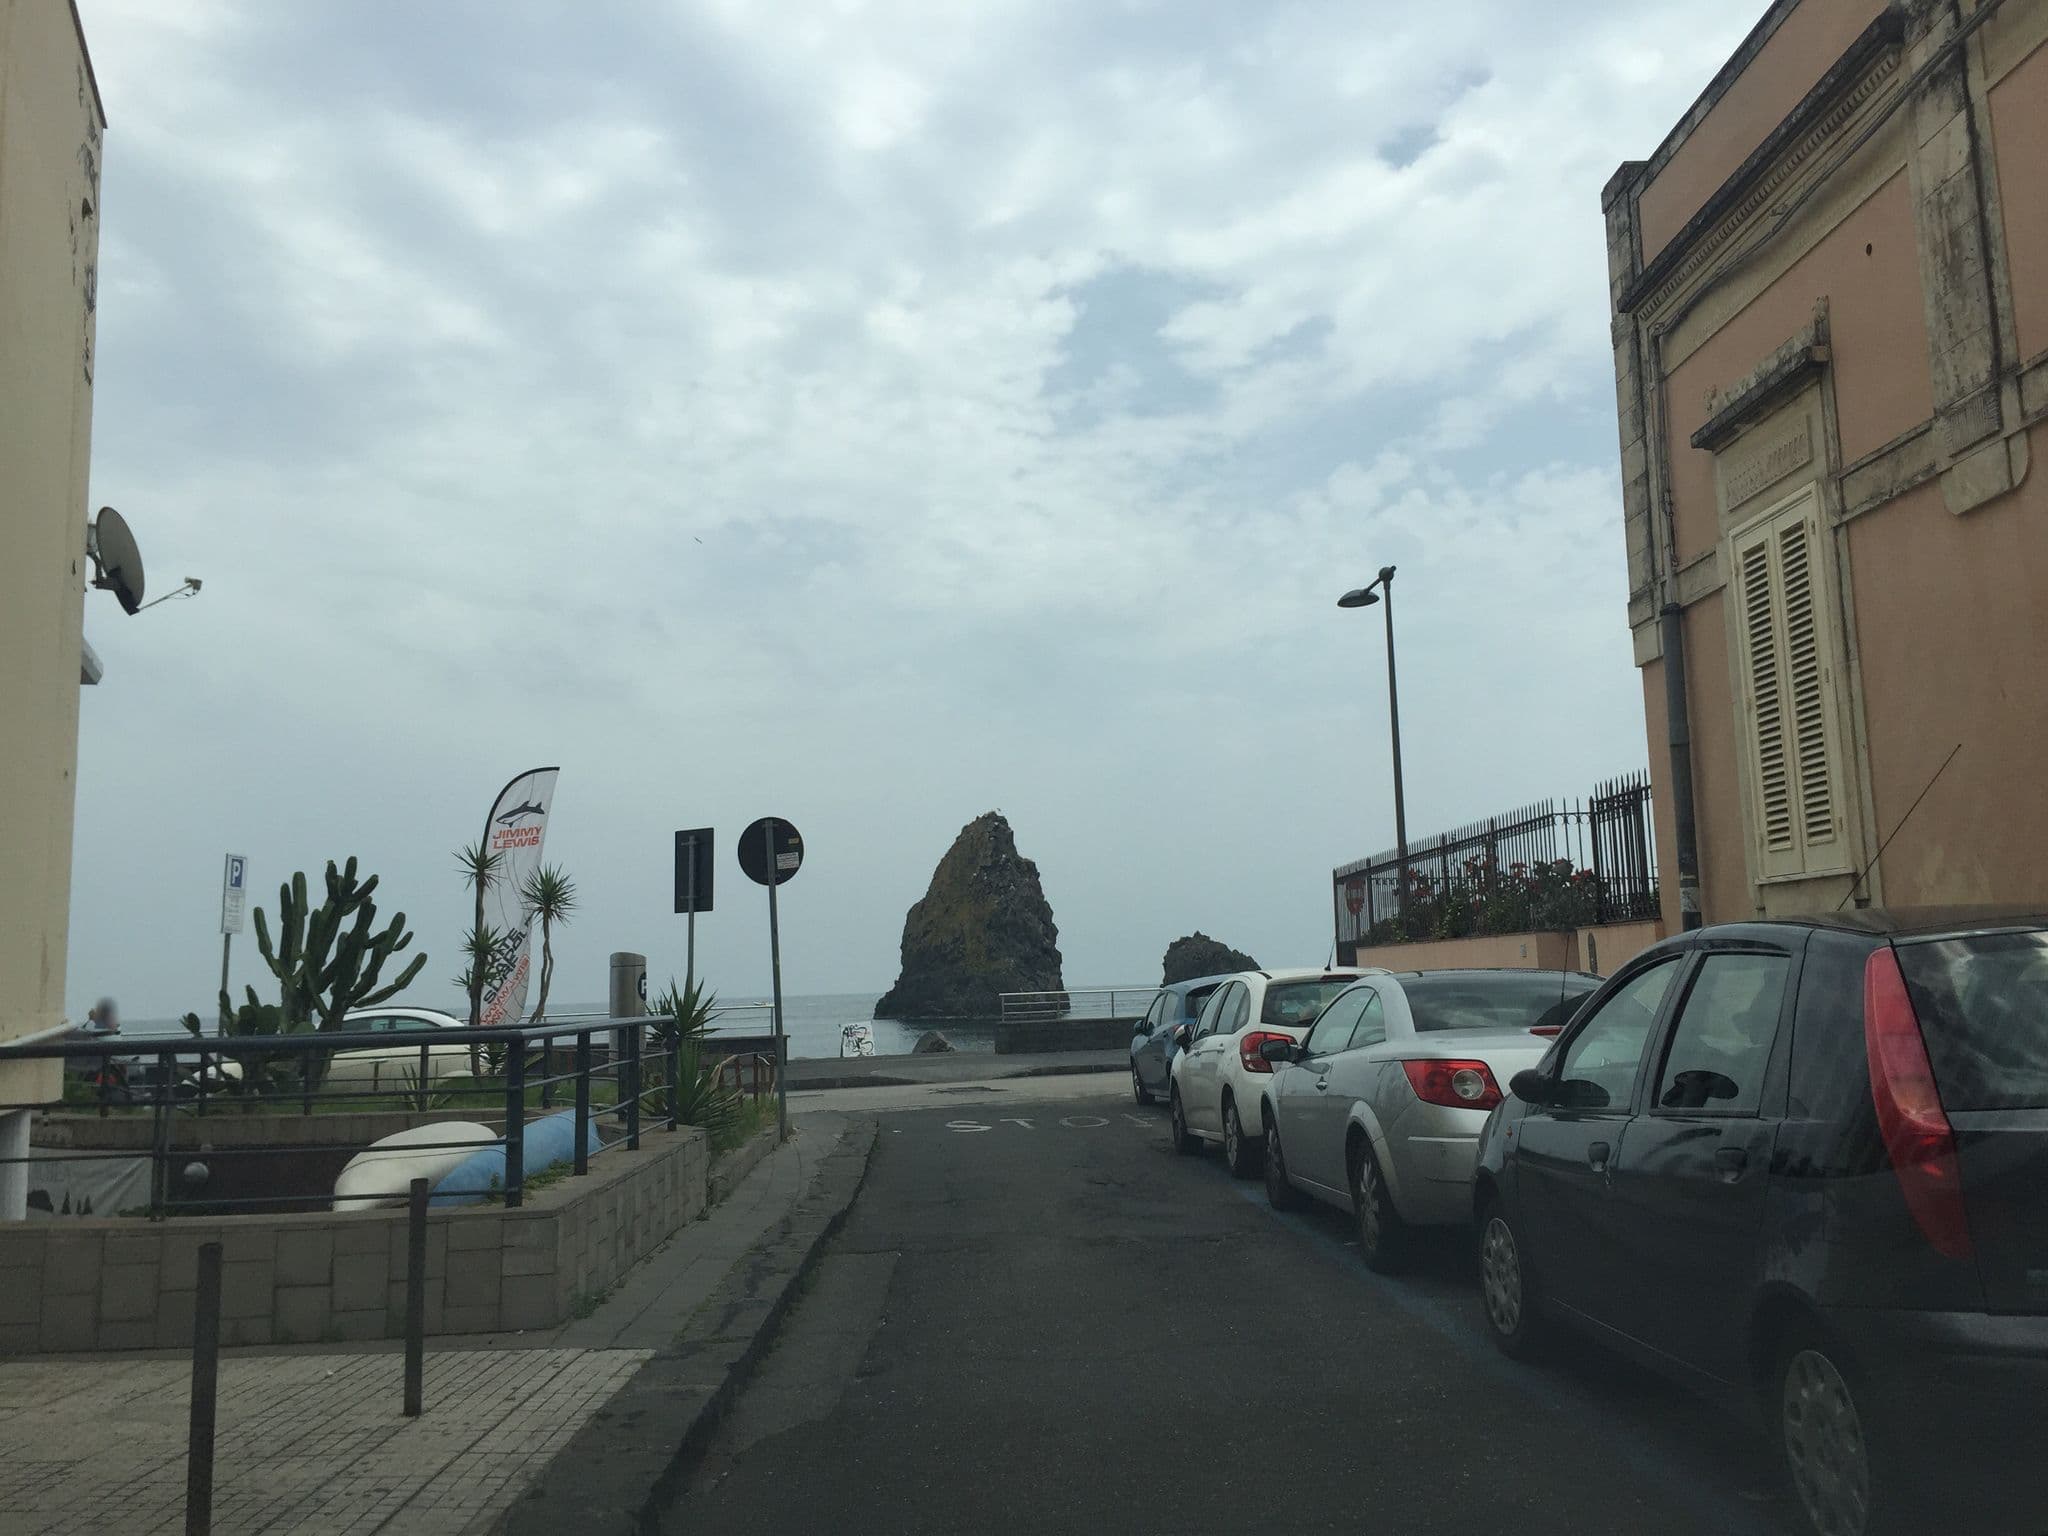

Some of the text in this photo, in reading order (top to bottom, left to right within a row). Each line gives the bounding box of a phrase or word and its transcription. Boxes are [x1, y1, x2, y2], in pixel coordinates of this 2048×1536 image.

[493, 826, 542, 839] JIMMY
[493, 836, 540, 849] LEWIS
[231, 860, 241, 885] P
